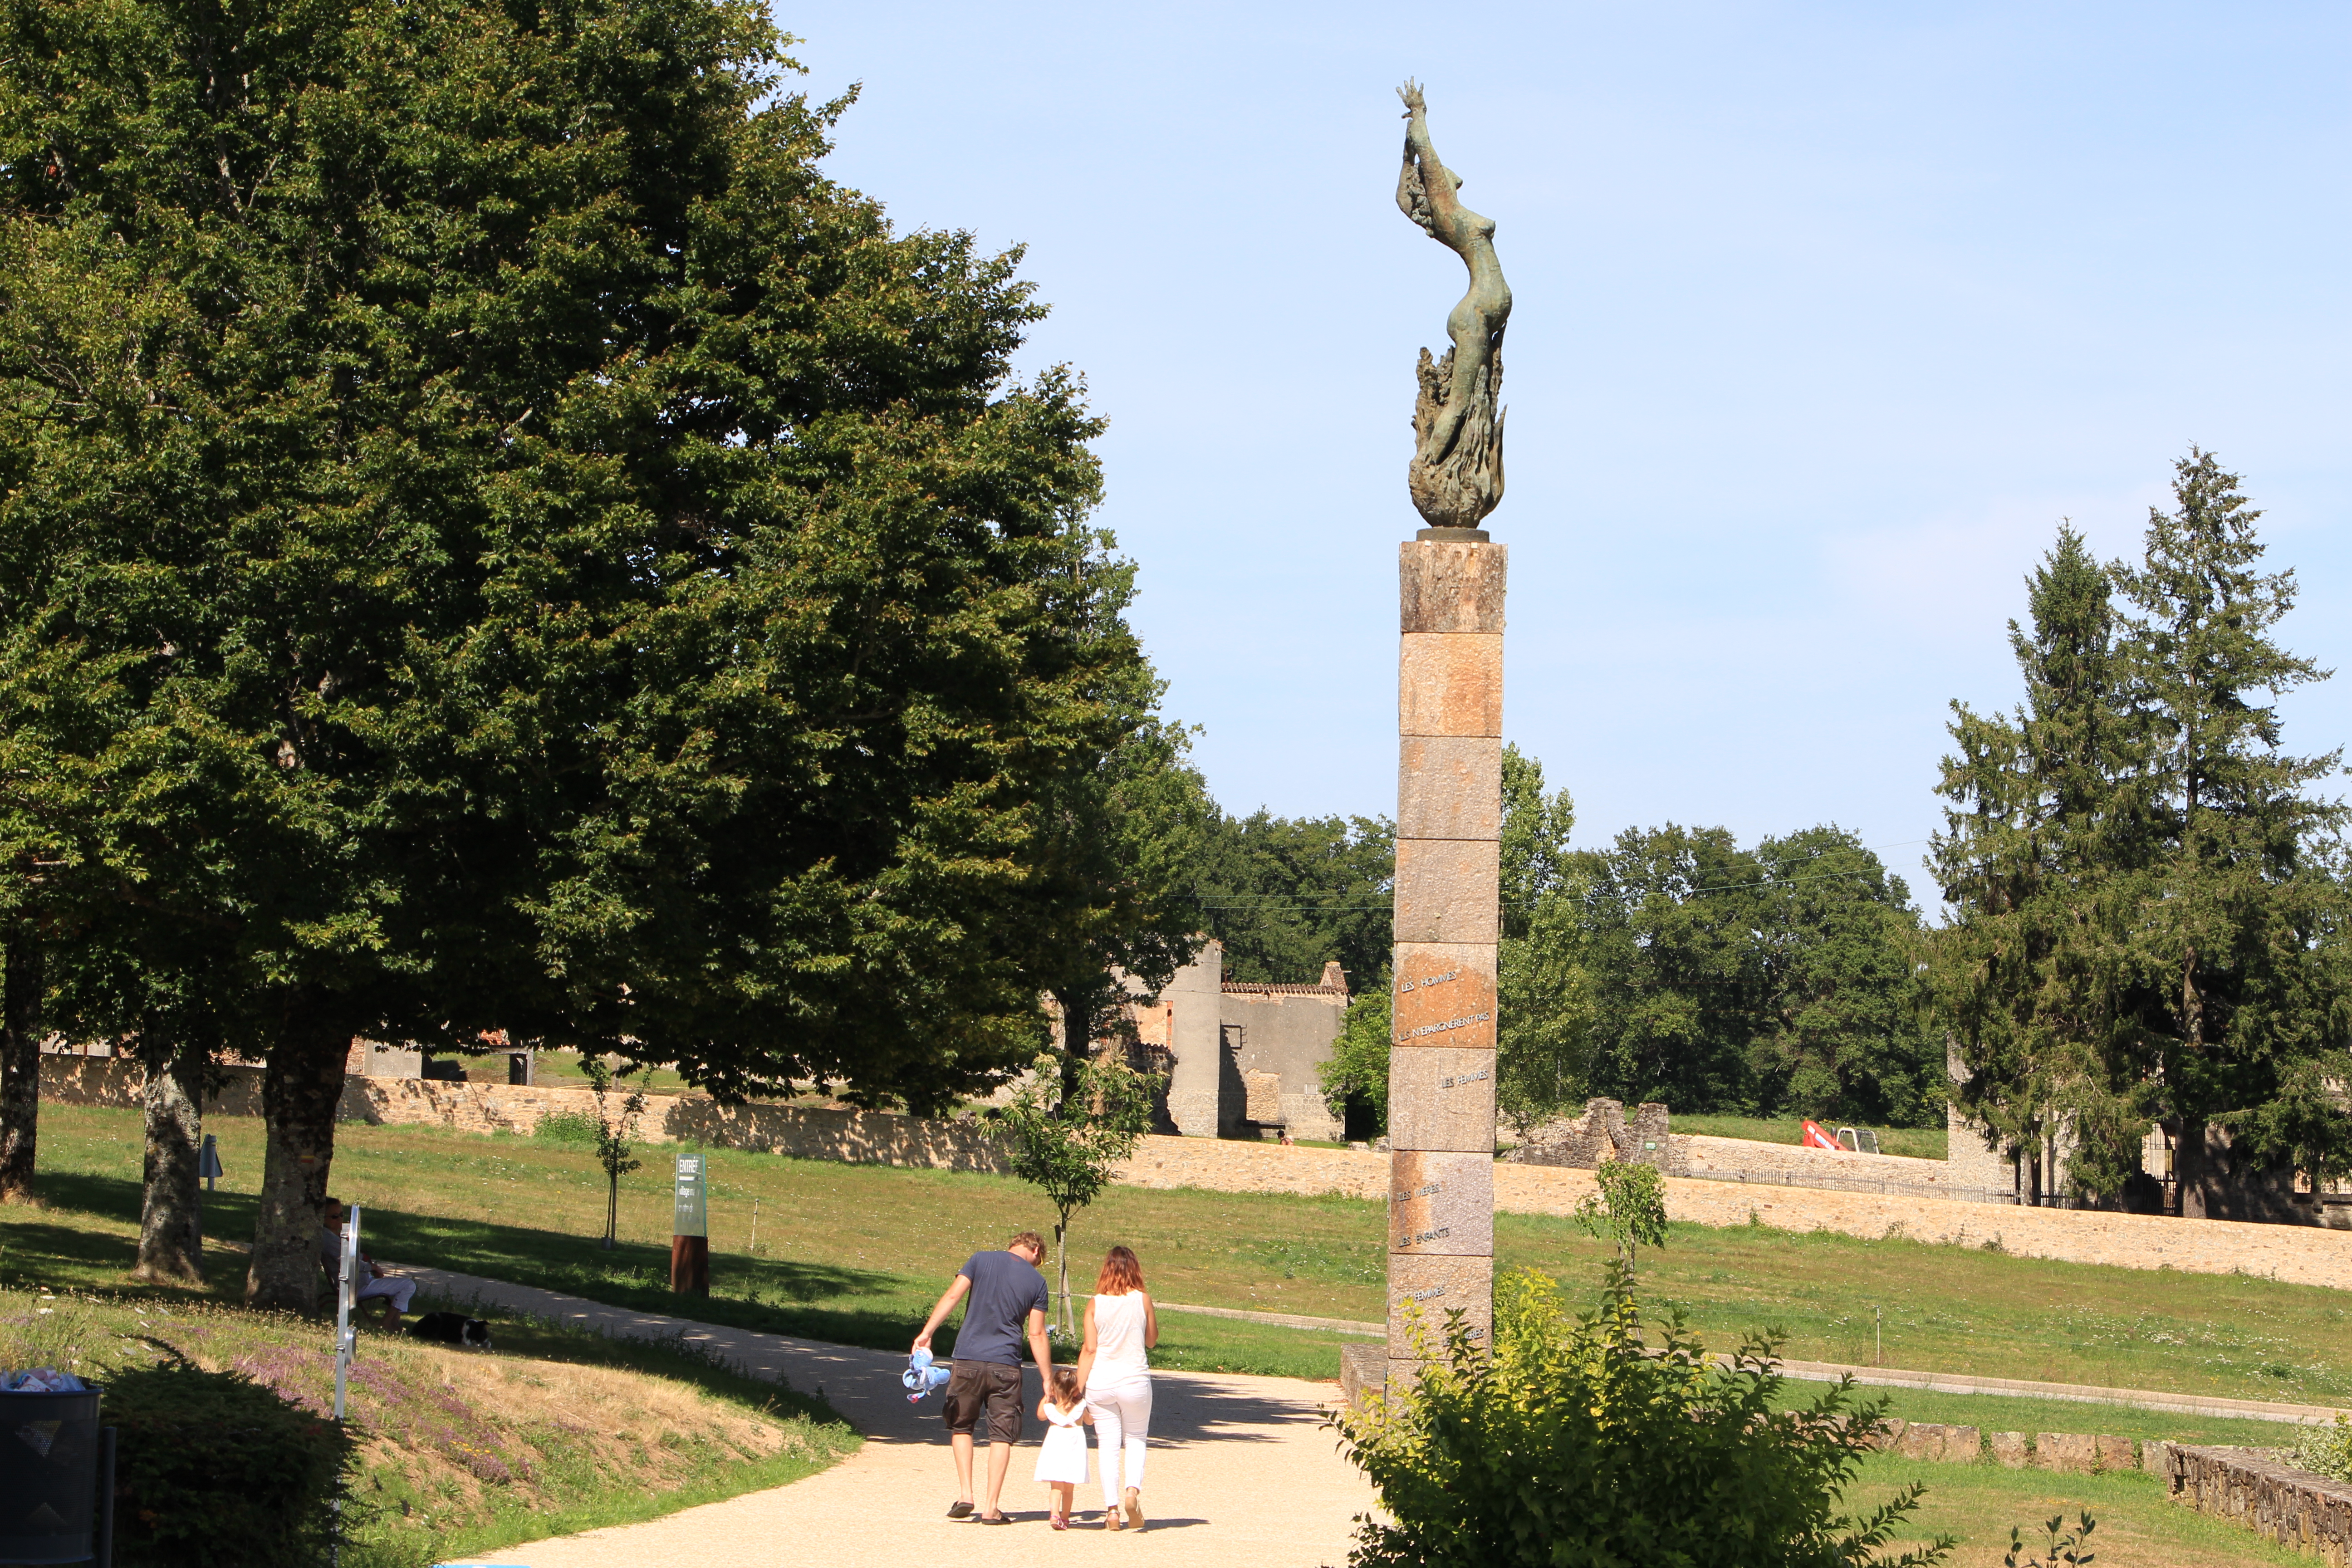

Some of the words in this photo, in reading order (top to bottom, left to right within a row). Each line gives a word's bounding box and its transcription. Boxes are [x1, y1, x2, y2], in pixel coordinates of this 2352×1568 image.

[1401, 981, 1414, 993] LES
[1421, 971, 1456, 987] HOMMES
[1475, 1012, 1489, 1022] PAS
[1442, 1077, 1454, 1088] LES
[1457, 1070, 1488, 1086] FEMMES
[1398, 1191, 1411, 1201] LES
[1415, 1184, 1440, 1197] MERES
[1399, 1236, 1411, 1247] LES
[1416, 1227, 1450, 1244] ENFANTS
[1414, 1286, 1445, 1302] FEMMES
